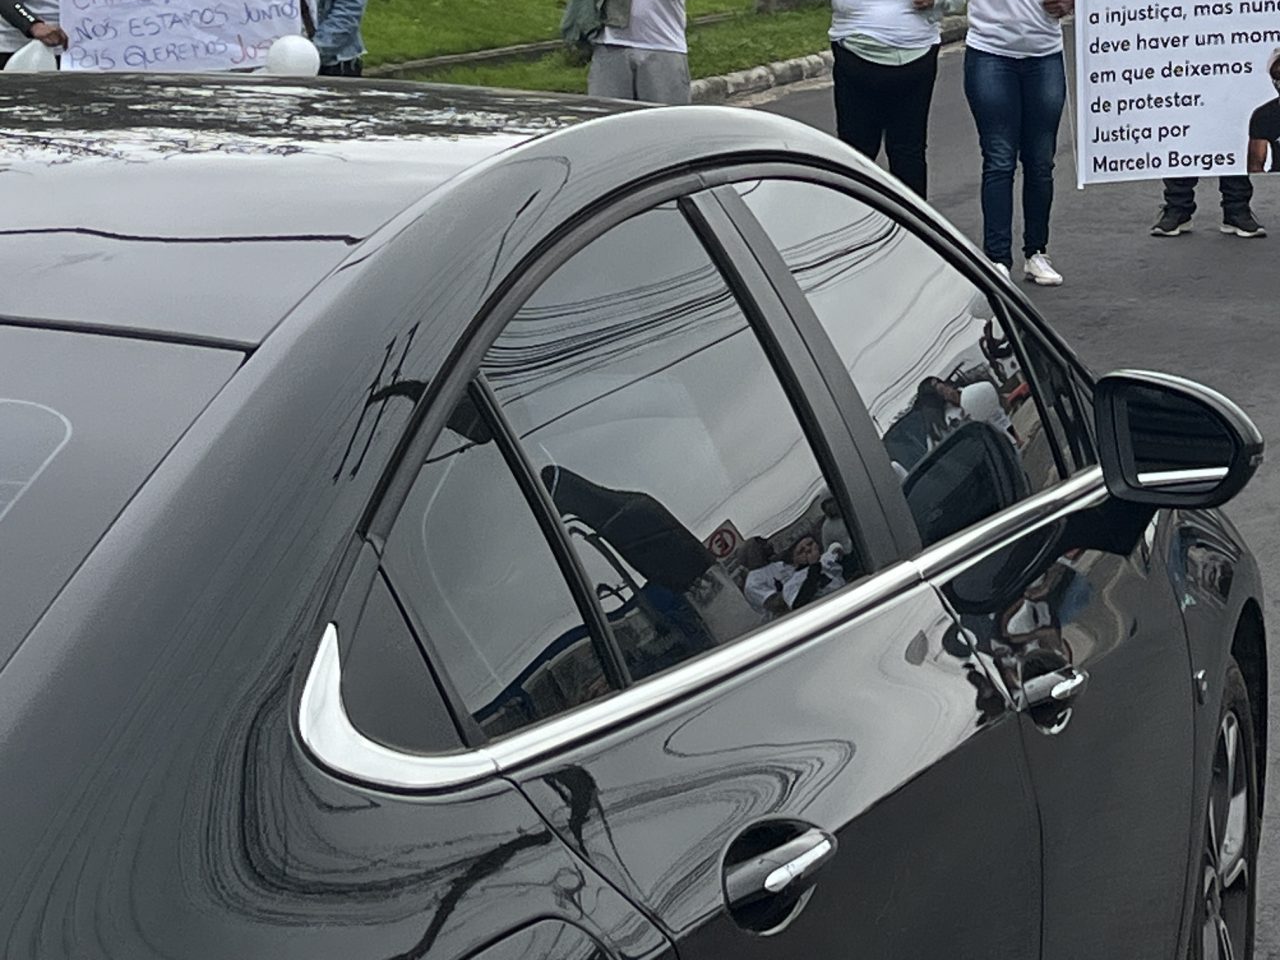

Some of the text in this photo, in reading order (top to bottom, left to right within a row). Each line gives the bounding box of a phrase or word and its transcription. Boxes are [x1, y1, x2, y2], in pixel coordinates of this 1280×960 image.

[128, 8, 229, 38] ESTAMOS
[1090, 13, 1099, 24] a
[1106, 4, 1186, 26] injustiça,
[1195, 3, 1233, 16] mas
[123, 40, 228, 70] QUEREMOS
[1090, 37, 1130, 54] deve
[1137, 34, 1189, 50] haver
[1196, 33, 1224, 46] um
[1090, 61, 1252, 84] em que deixemos
[1091, 92, 1203, 115] de protestar.
[1092, 125, 1190, 143] Justiça por
[1094, 151, 1235, 172] Marcelo Borges
